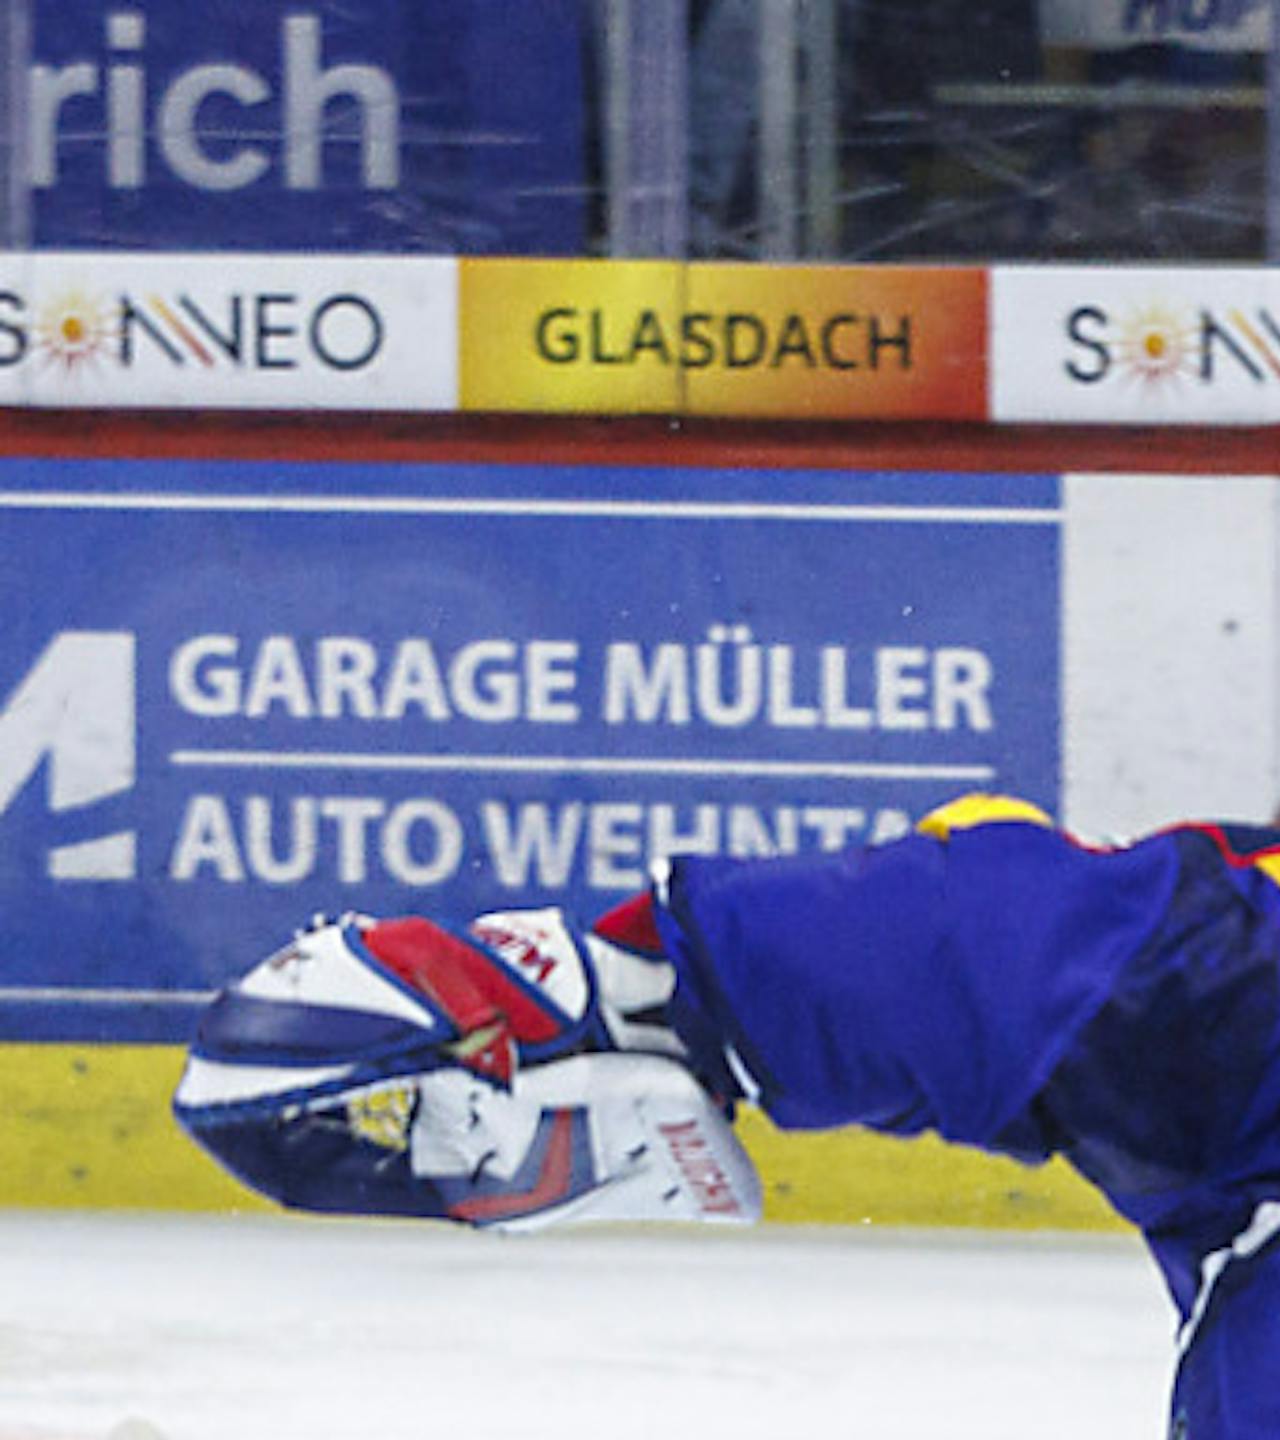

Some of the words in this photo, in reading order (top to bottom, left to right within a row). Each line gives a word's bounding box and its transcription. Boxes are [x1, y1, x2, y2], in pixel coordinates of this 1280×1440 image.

[27, 15, 399, 191] rich
[534, 305, 914, 373] GLASDACH
[171, 635, 578, 723] GARAGE
[605, 624, 993, 732] MÜLLER
[171, 796, 463, 883] AUTO
